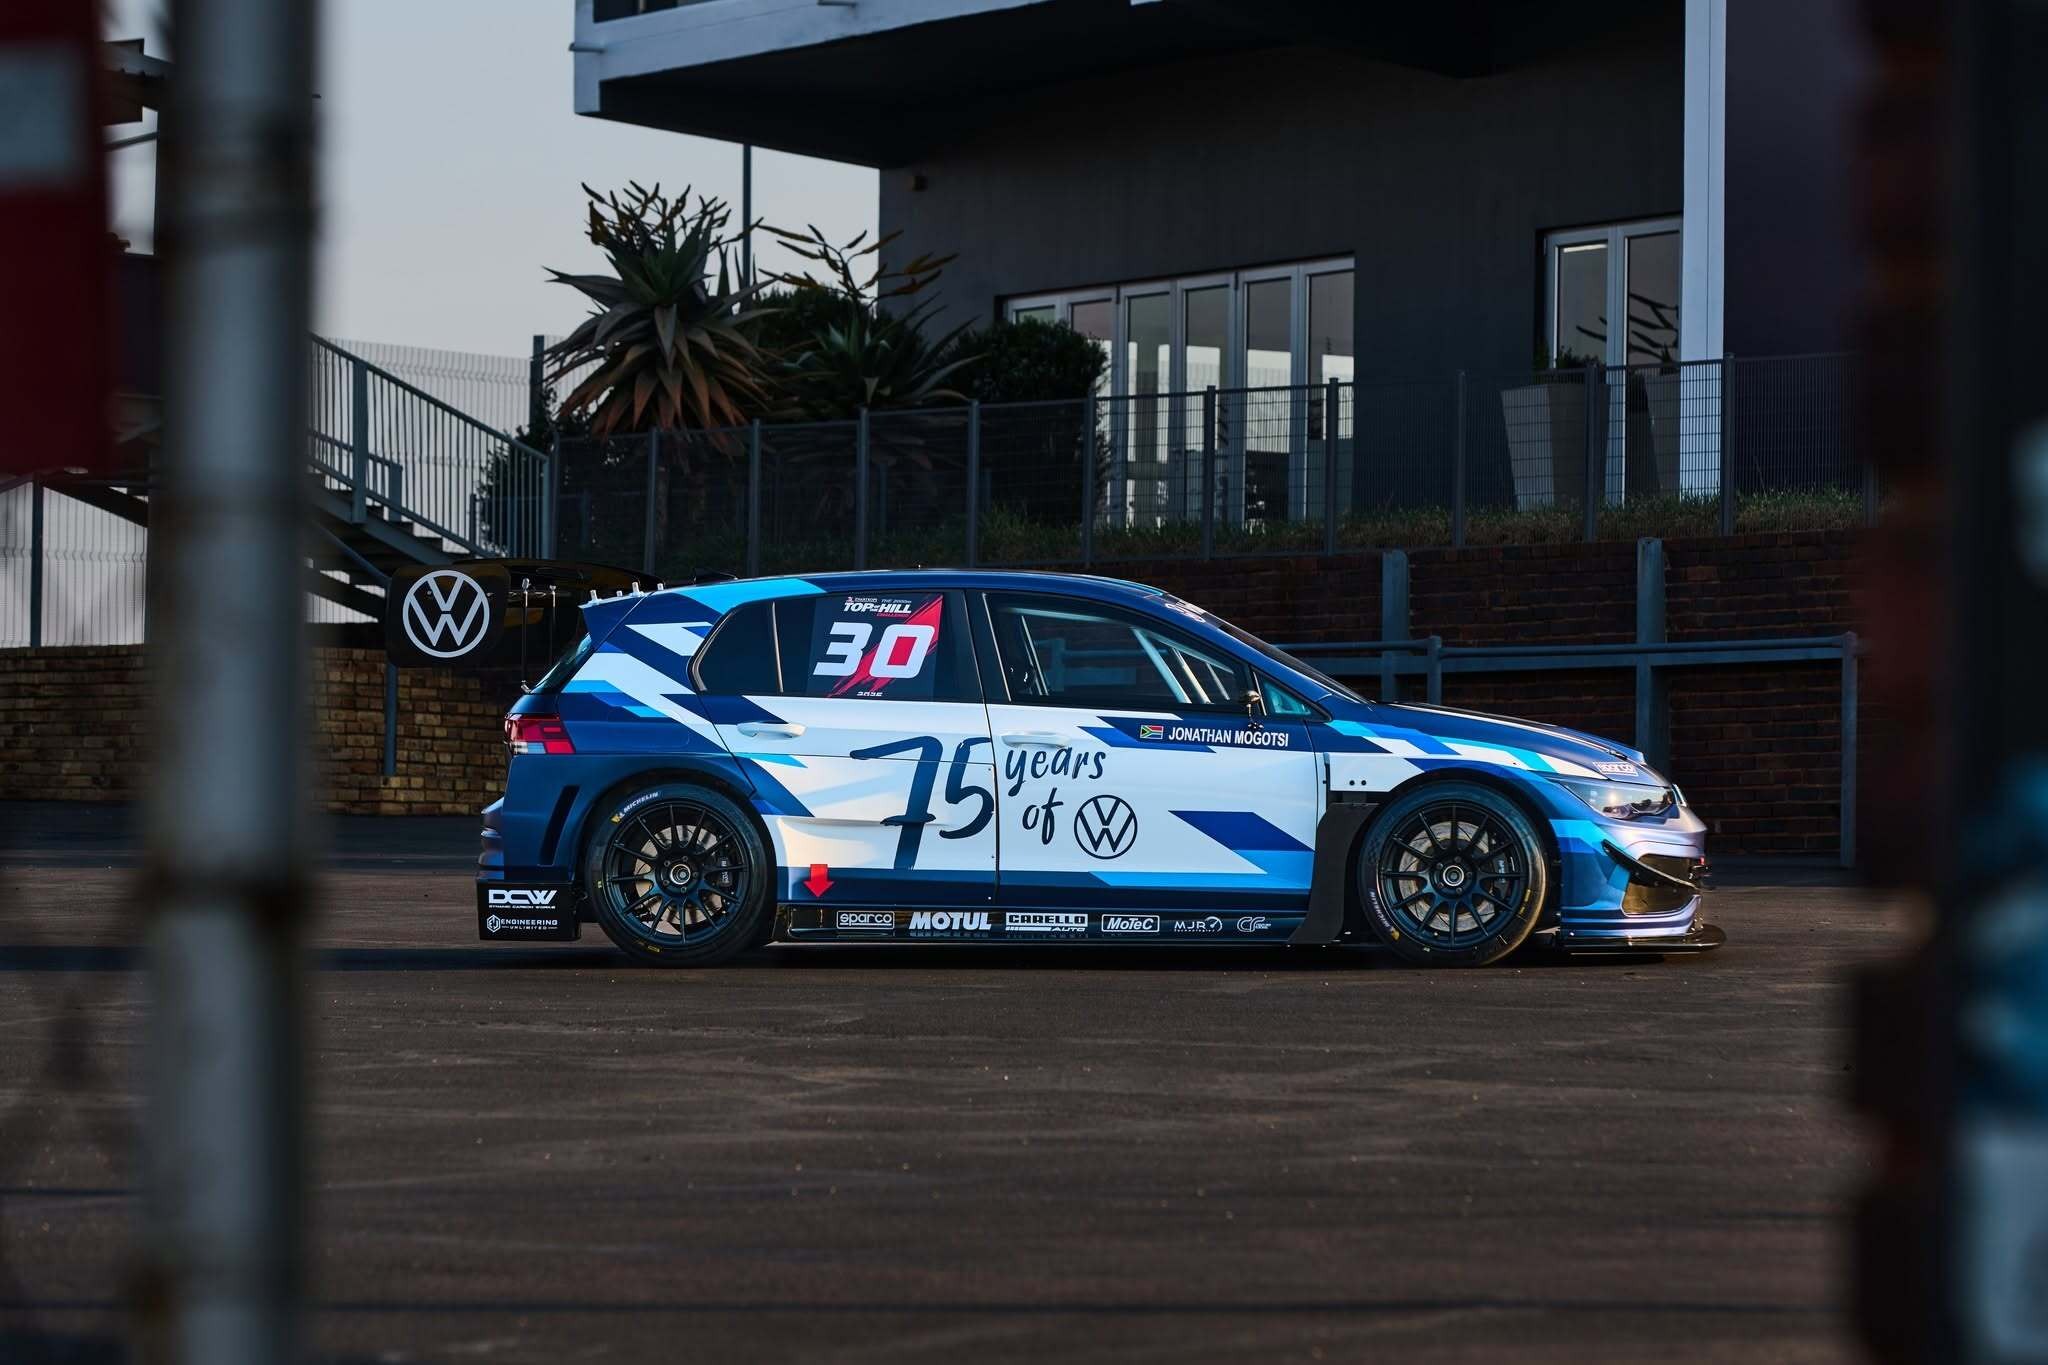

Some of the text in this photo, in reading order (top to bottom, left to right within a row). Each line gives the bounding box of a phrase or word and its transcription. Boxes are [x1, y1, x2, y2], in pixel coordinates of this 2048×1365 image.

[402, 569, 490, 658] VW
[844, 602, 873, 612] TOP
[878, 603, 912, 613] HILL
[813, 621, 935, 679] 30
[1169, 726, 1289, 747] JONATHAN MOGOTSI
[1005, 746, 1106, 797] years
[850, 735, 994, 869] 75
[1022, 787, 1064, 845] of
[1073, 794, 1138, 860] VW
[488, 889, 558, 905] DCW
[500, 918, 558, 926] ENGINEERING
[839, 912, 892, 926] sparco
[909, 912, 992, 931] MOTUL
[1008, 914, 1086, 924] CARELLO
[1107, 917, 1154, 930] MoTeC
[1174, 920, 1207, 930] MJR
